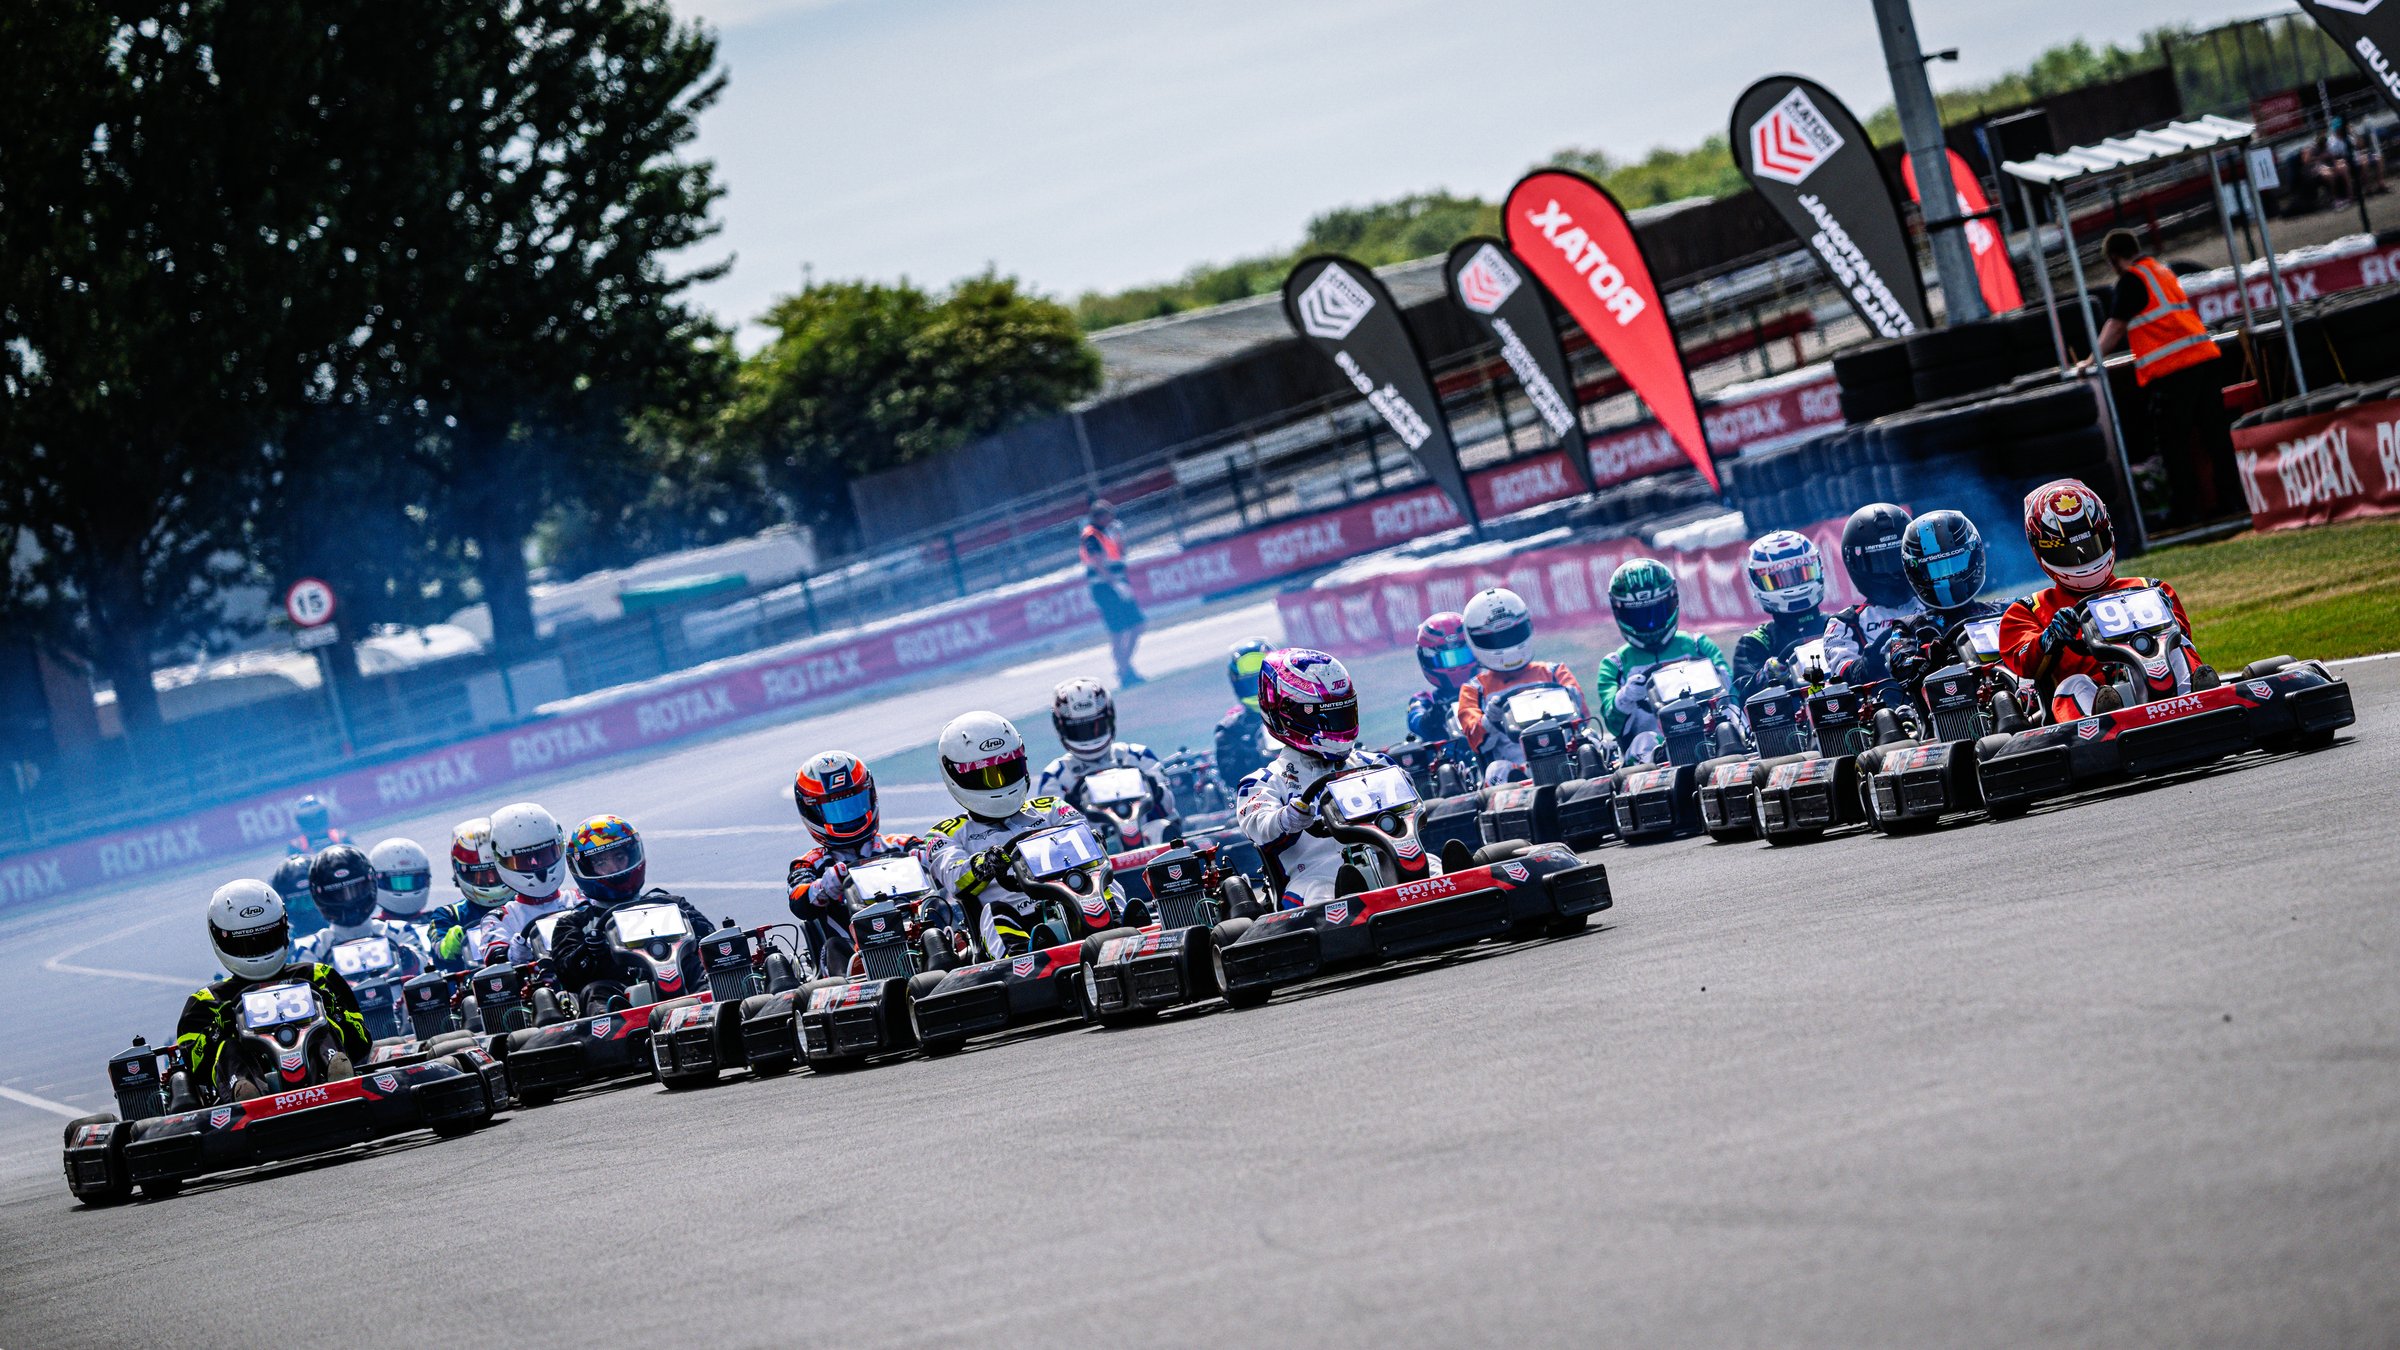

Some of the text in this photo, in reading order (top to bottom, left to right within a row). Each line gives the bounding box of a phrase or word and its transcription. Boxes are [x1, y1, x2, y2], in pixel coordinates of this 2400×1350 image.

[1489, 458, 1570, 508] ROTAX
[2277, 426, 2365, 509] ROTAX
[1256, 518, 1347, 569] ROTAX
[1918, 547, 1966, 564] Kartletics.com
[1146, 548, 1239, 597] ROTAX
[1767, 558, 1815, 572] HONDA
[297, 590, 324, 617] 15
[1024, 584, 1099, 630] ROTA
[892, 612, 996, 664] ROTAX
[761, 646, 867, 702] ROTAX
[636, 684, 736, 738] ROTAX
[2146, 695, 2202, 715] ROTAX
[2149, 703, 2204, 720] RACING
[508, 717, 609, 770] ROTAX
[982, 739, 1003, 749] Arai
[376, 749, 479, 804] ROTAX
[99, 824, 203, 877] ROTAX
[1022, 829, 1092, 873] 71
[1396, 878, 1453, 898] ROTAX
[1400, 885, 1457, 902] RACING
[243, 905, 264, 916] Arai
[231, 927, 254, 936] UNITED
[254, 922, 281, 933] KINGDOM
[247, 991, 310, 1023] 93
[275, 1087, 327, 1106] ROTAX
[276, 1094, 329, 1111] RACING
